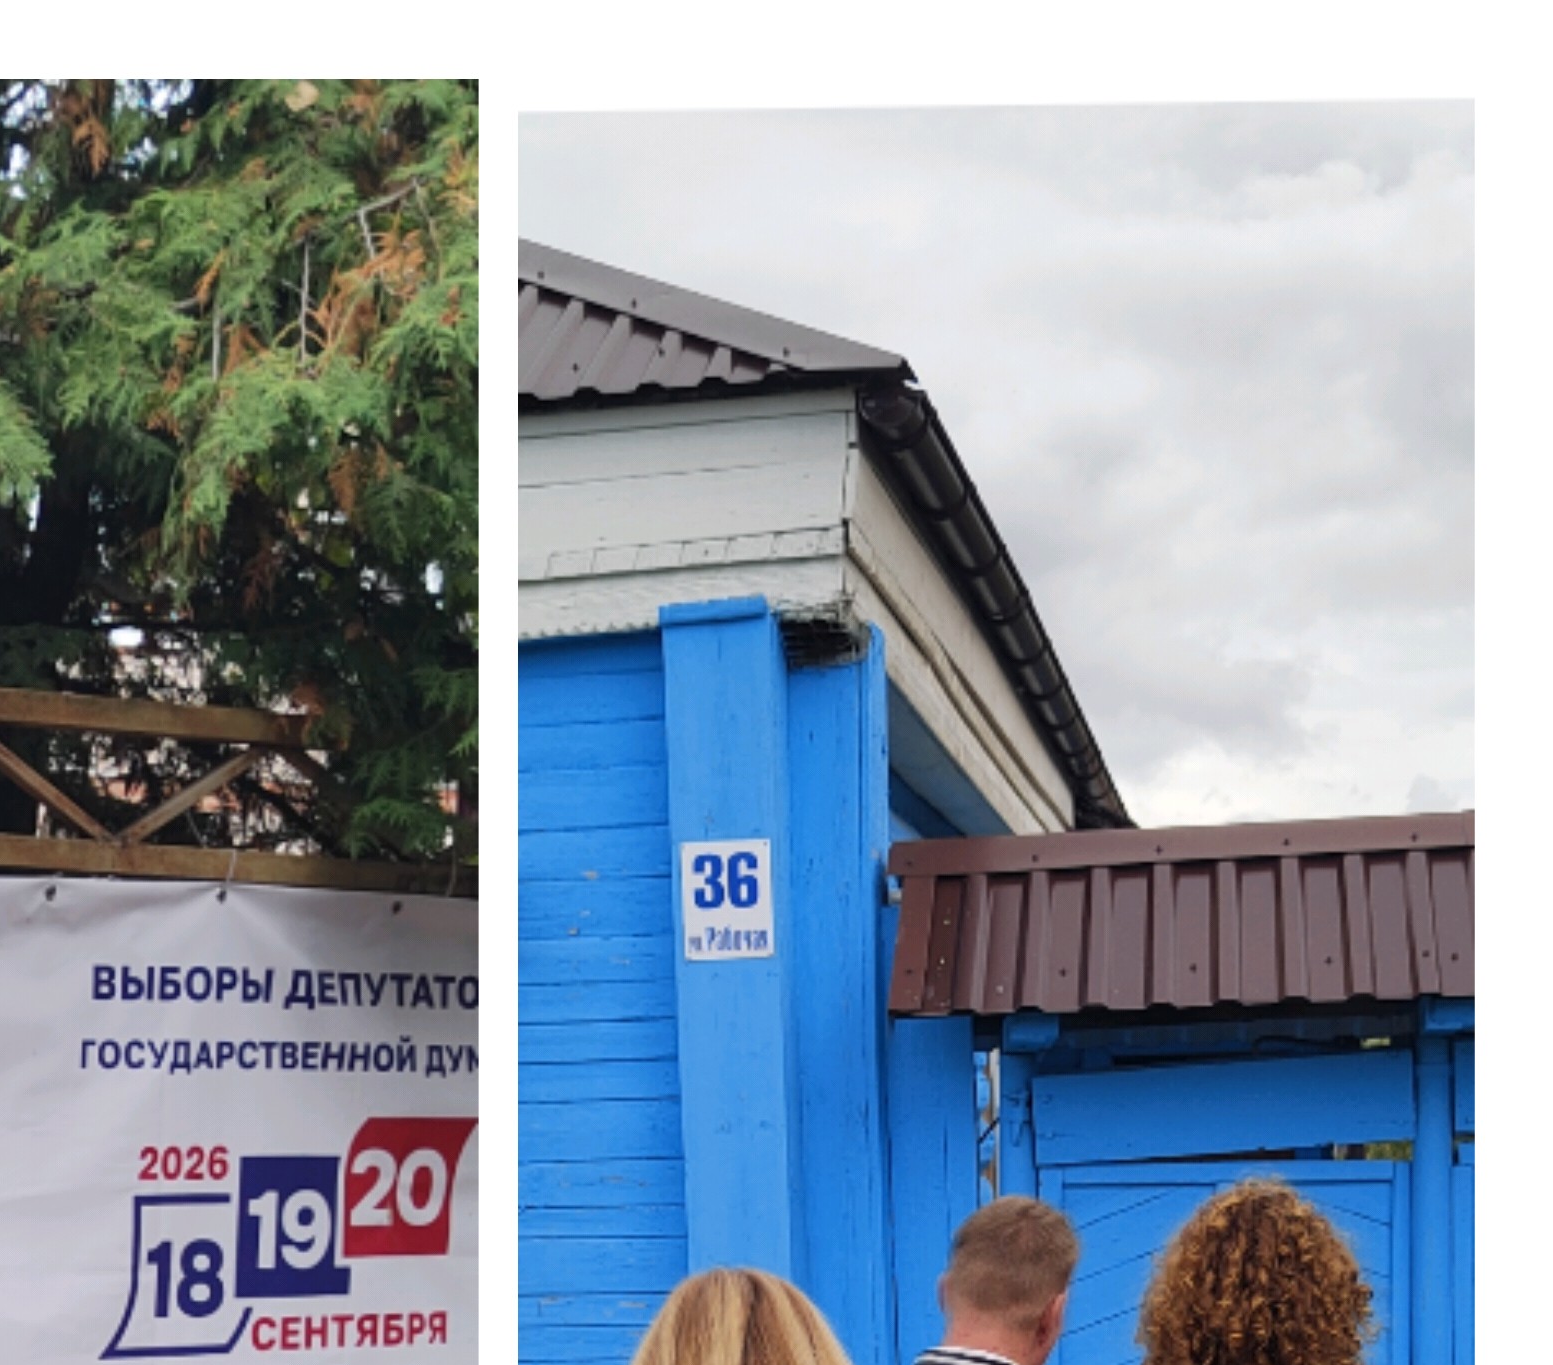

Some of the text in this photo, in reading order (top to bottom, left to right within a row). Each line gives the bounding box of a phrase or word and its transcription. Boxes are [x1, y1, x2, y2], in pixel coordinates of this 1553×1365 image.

[693, 851, 758, 909] 36
[92, 965, 478, 1010] ВЫБОРЫ ДЕПУТАТО
[80, 1035, 416, 1075] ГОСУДАРСТВЕННОЙ
[138, 1146, 229, 1180] 2026
[147, 1147, 447, 1318] 18 19 20
[251, 1311, 448, 1351] СЕНТЯБРЯ
